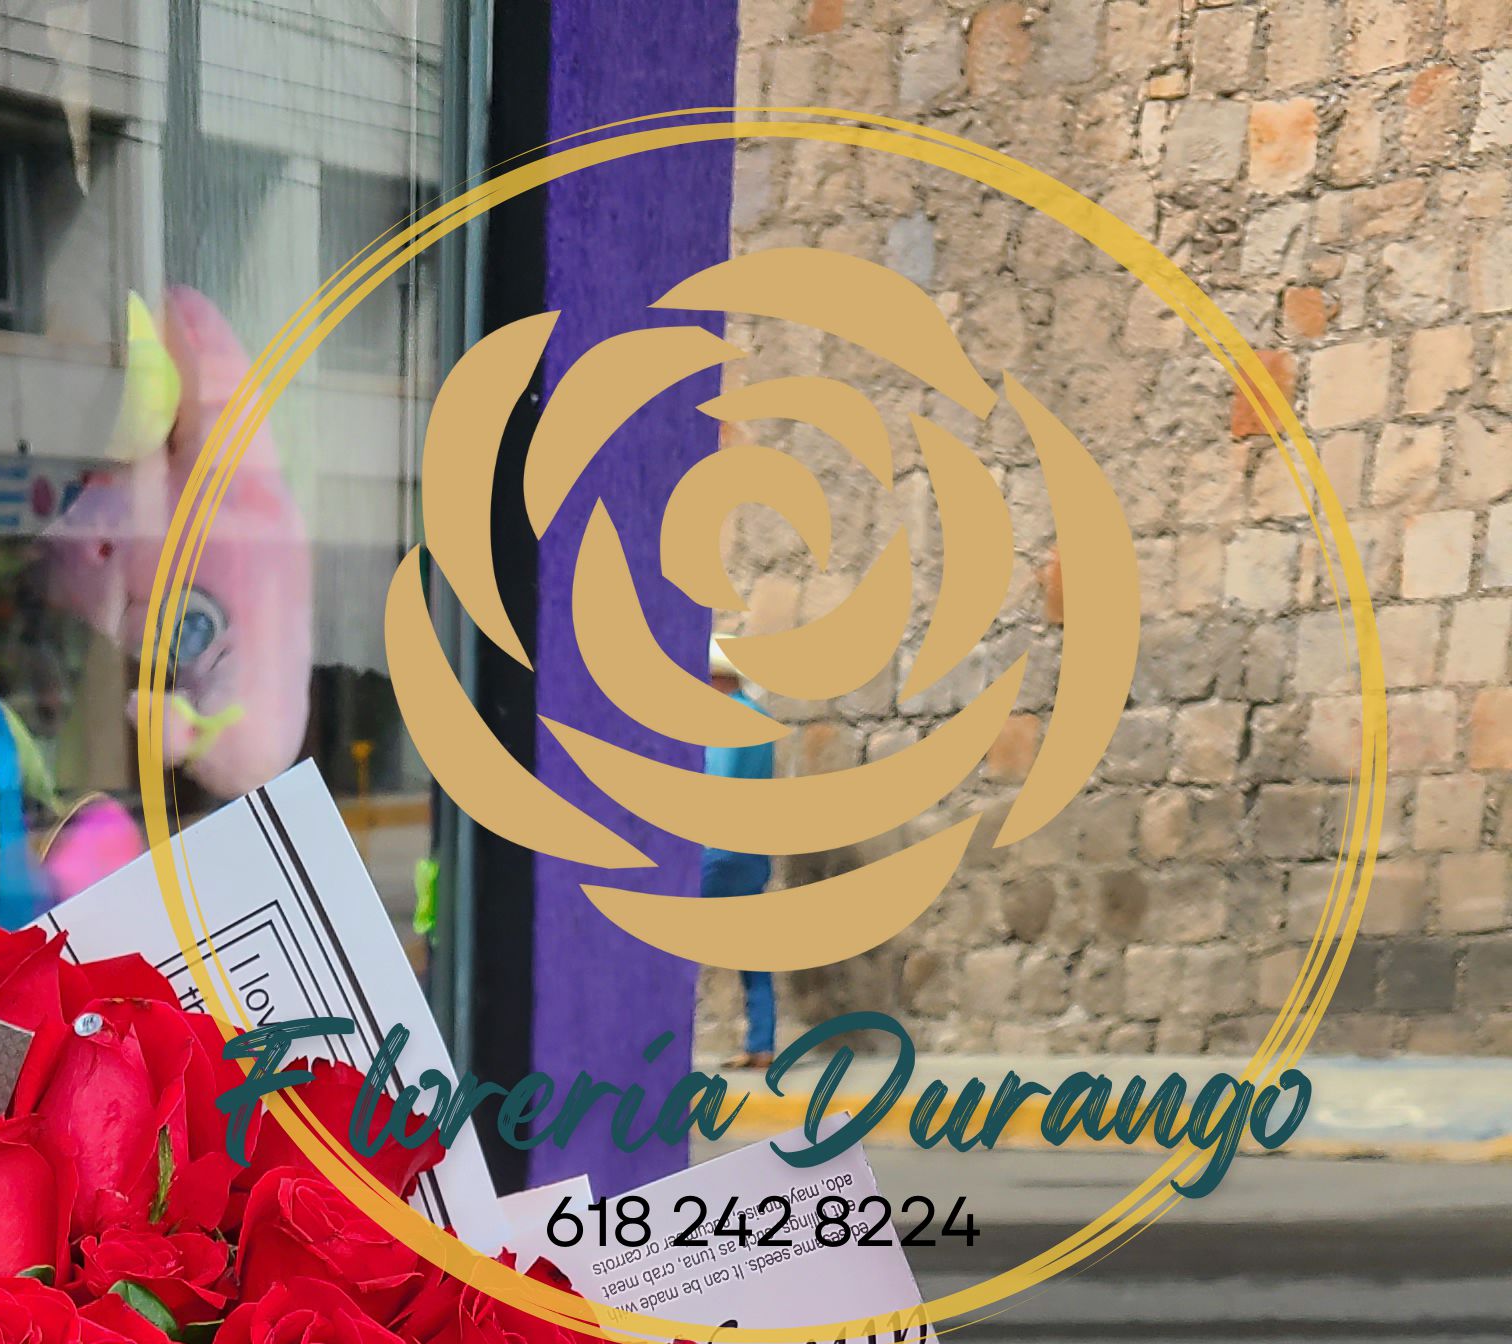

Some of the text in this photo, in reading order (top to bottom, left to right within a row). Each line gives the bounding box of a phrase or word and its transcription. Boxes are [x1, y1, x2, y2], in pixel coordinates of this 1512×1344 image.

[591, 1172, 853, 1276] ado, or carrots
[600, 1239, 737, 1300] as tuna, crab meat
[743, 1243, 791, 1274] seeds.
[680, 1277, 703, 1295] be
[702, 1268, 730, 1287] can
[638, 1285, 680, 1312] made
